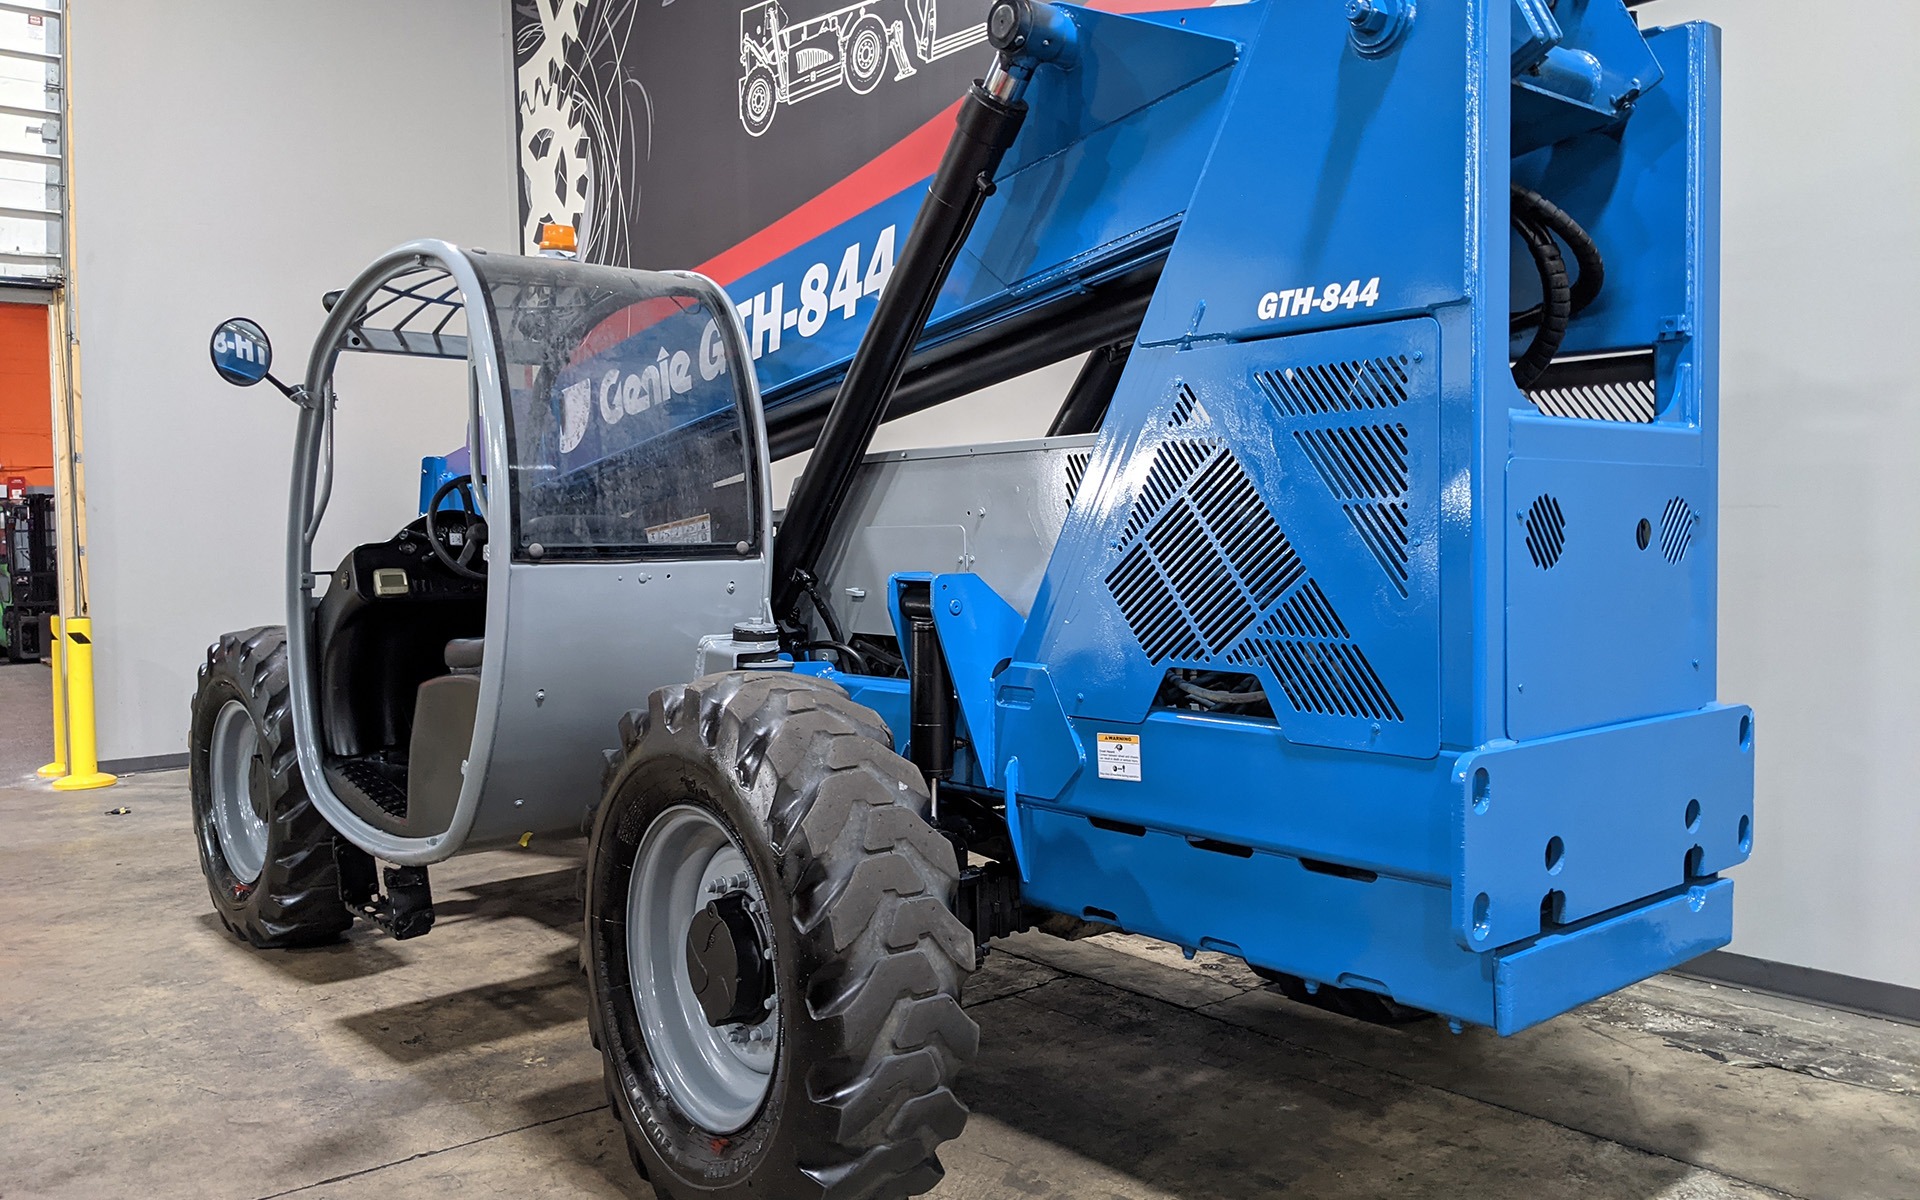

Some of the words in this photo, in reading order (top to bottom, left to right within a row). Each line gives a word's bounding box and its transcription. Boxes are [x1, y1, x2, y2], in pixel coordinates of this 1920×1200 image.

[600, 346, 692, 424] Genie
[699, 224, 895, 381] GH-844
[1257, 277, 1380, 320] GTH-844
